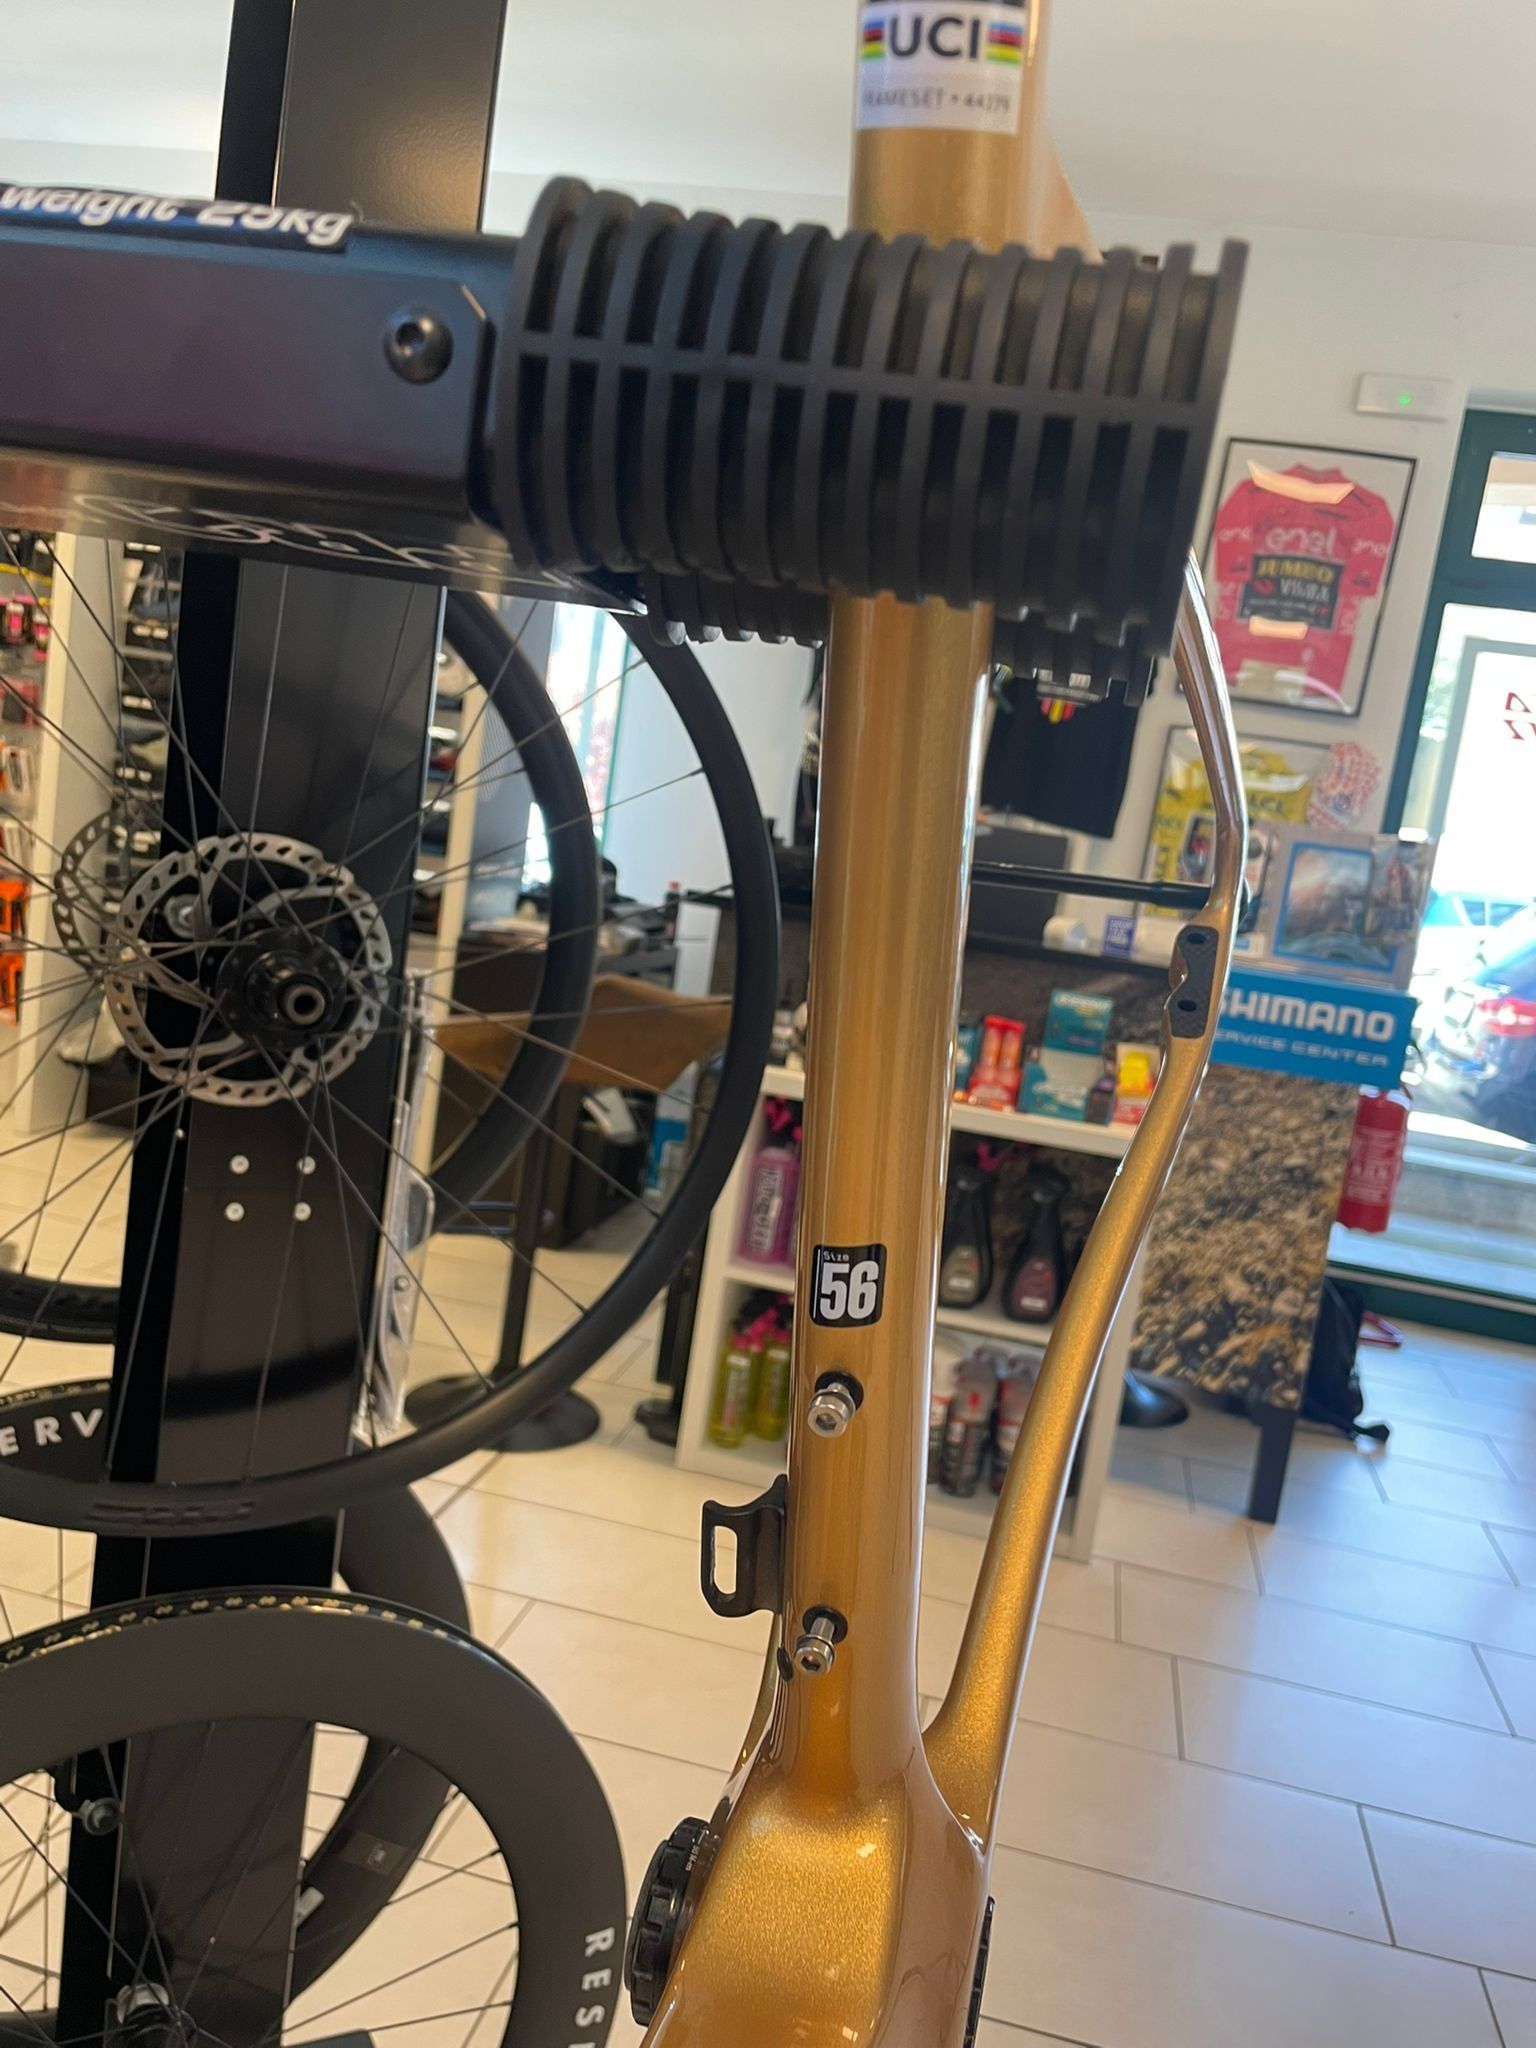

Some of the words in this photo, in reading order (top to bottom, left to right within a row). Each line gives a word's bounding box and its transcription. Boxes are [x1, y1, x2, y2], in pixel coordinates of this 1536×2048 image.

[889, 15, 981, 60] UCI
[1215, 1030, 1288, 1051] ERVICE
[1291, 1041, 1388, 1067] CENTER
[819, 1260, 880, 1321] 56
[567, 1926, 616, 2048] RES
